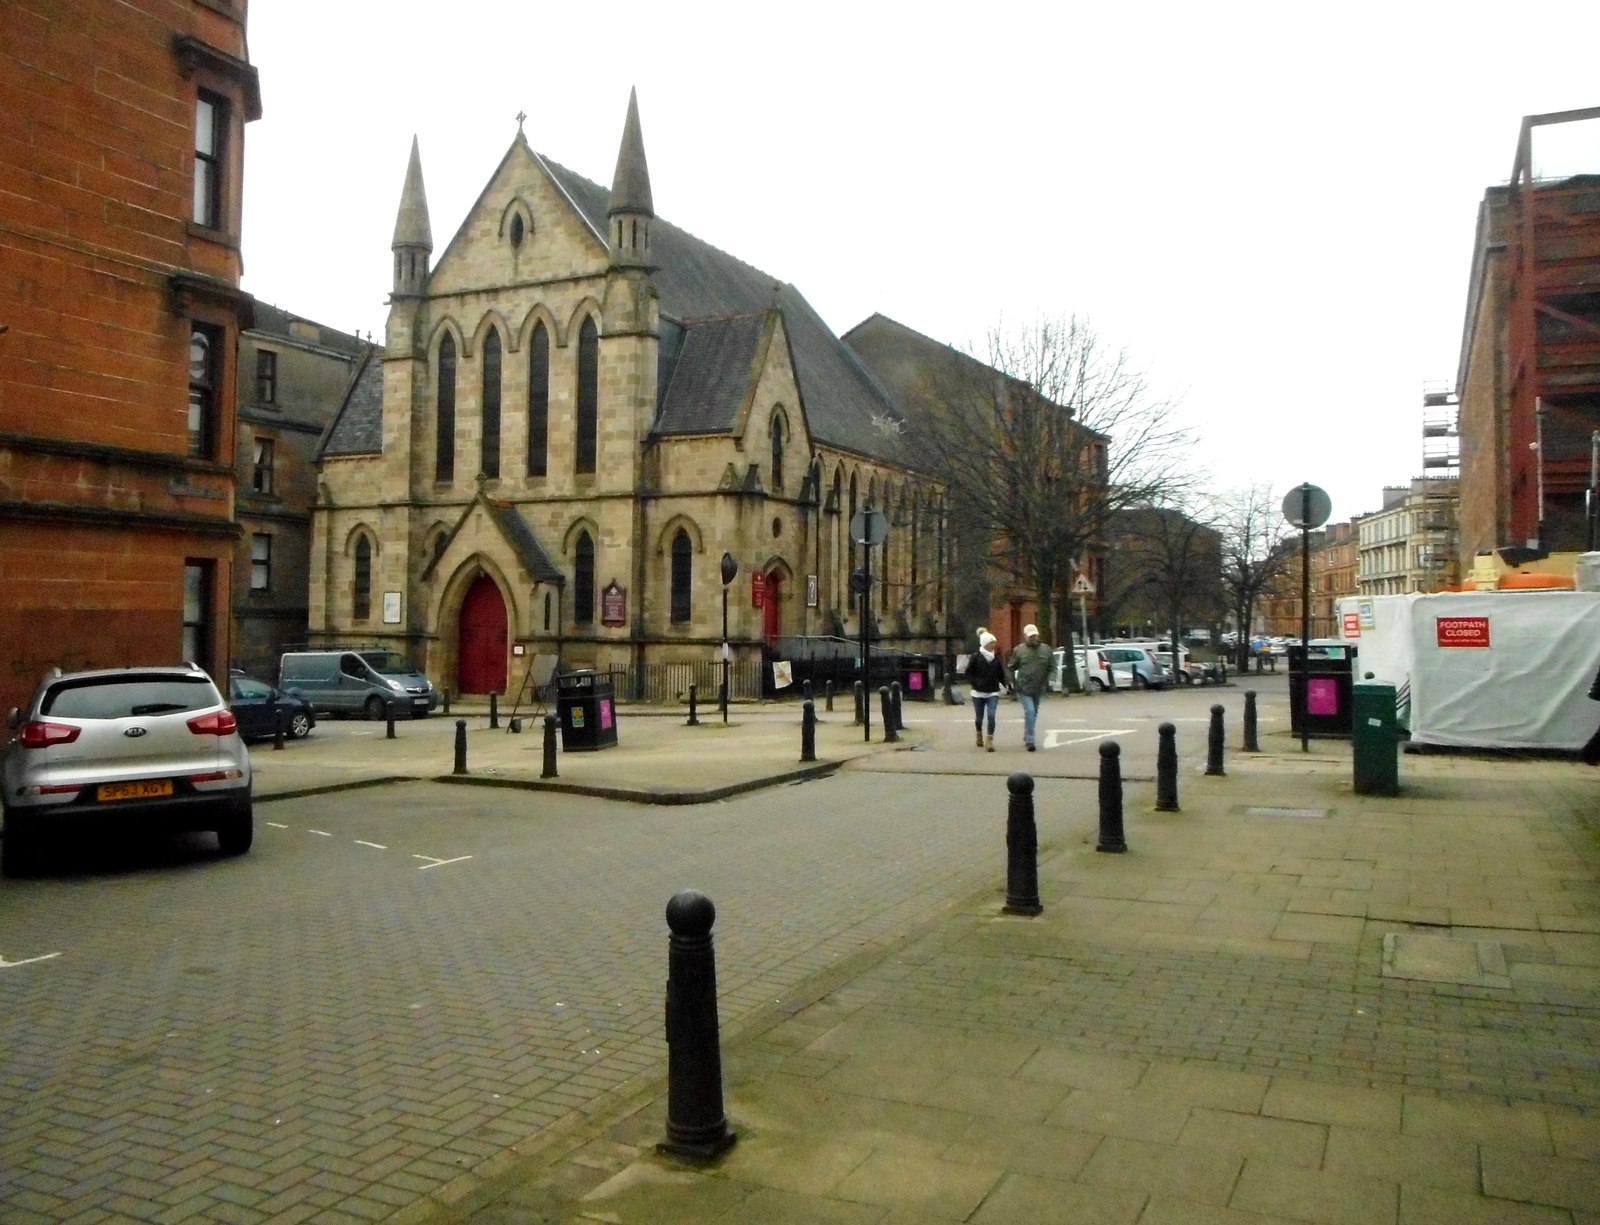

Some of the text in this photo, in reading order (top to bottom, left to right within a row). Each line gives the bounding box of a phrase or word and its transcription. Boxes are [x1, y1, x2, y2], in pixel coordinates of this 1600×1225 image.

[1440, 621, 1486, 629] FOOTPATH
[1445, 629, 1481, 637] CLOSED
[127, 728, 144, 736] KIA
